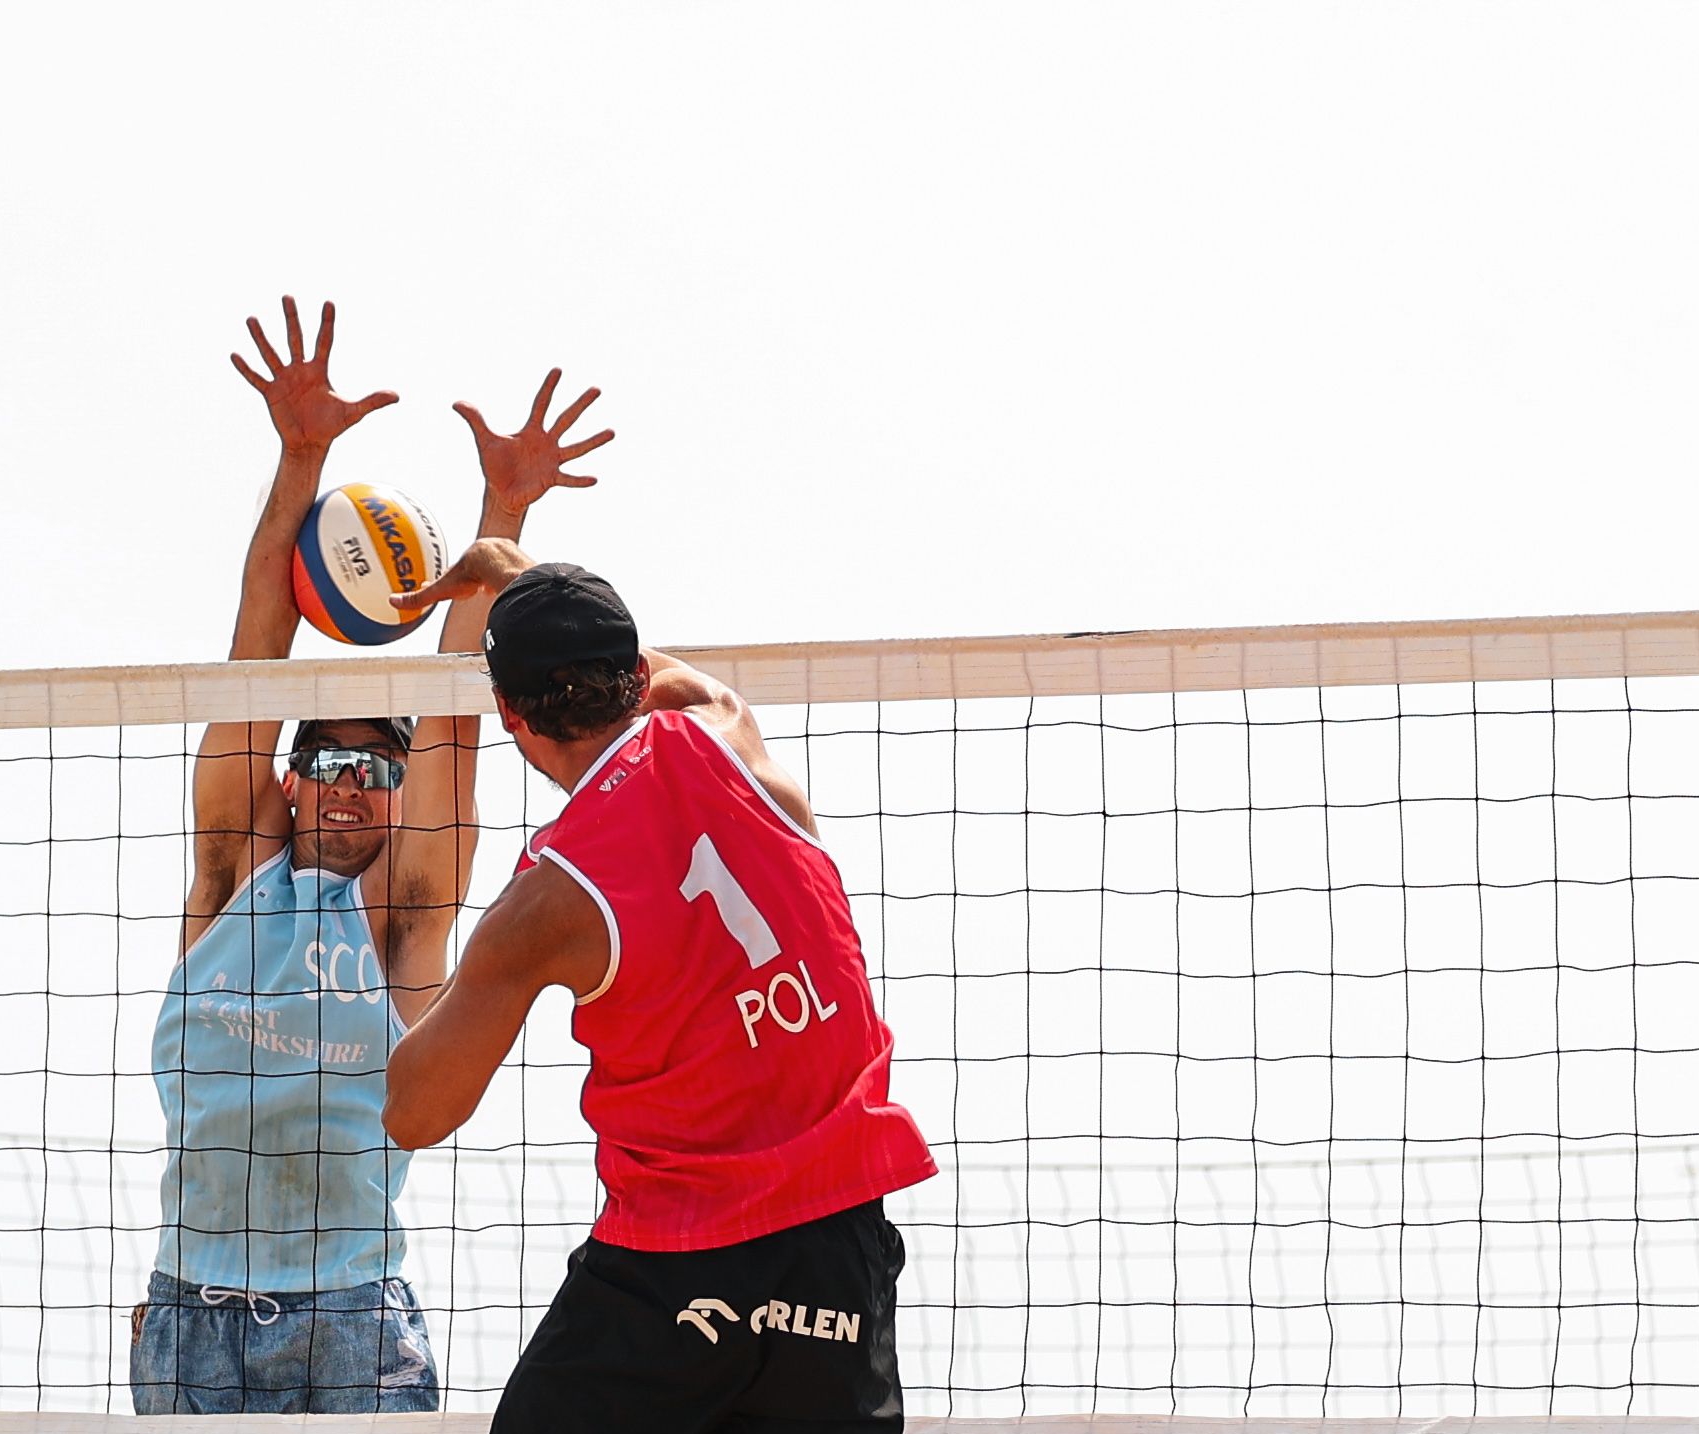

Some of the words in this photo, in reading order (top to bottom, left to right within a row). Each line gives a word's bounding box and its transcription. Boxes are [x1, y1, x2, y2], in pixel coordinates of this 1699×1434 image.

[680, 832, 782, 970] 1
[221, 1019, 369, 1063] YORKSHIRE
[735, 960, 837, 1048] POL
